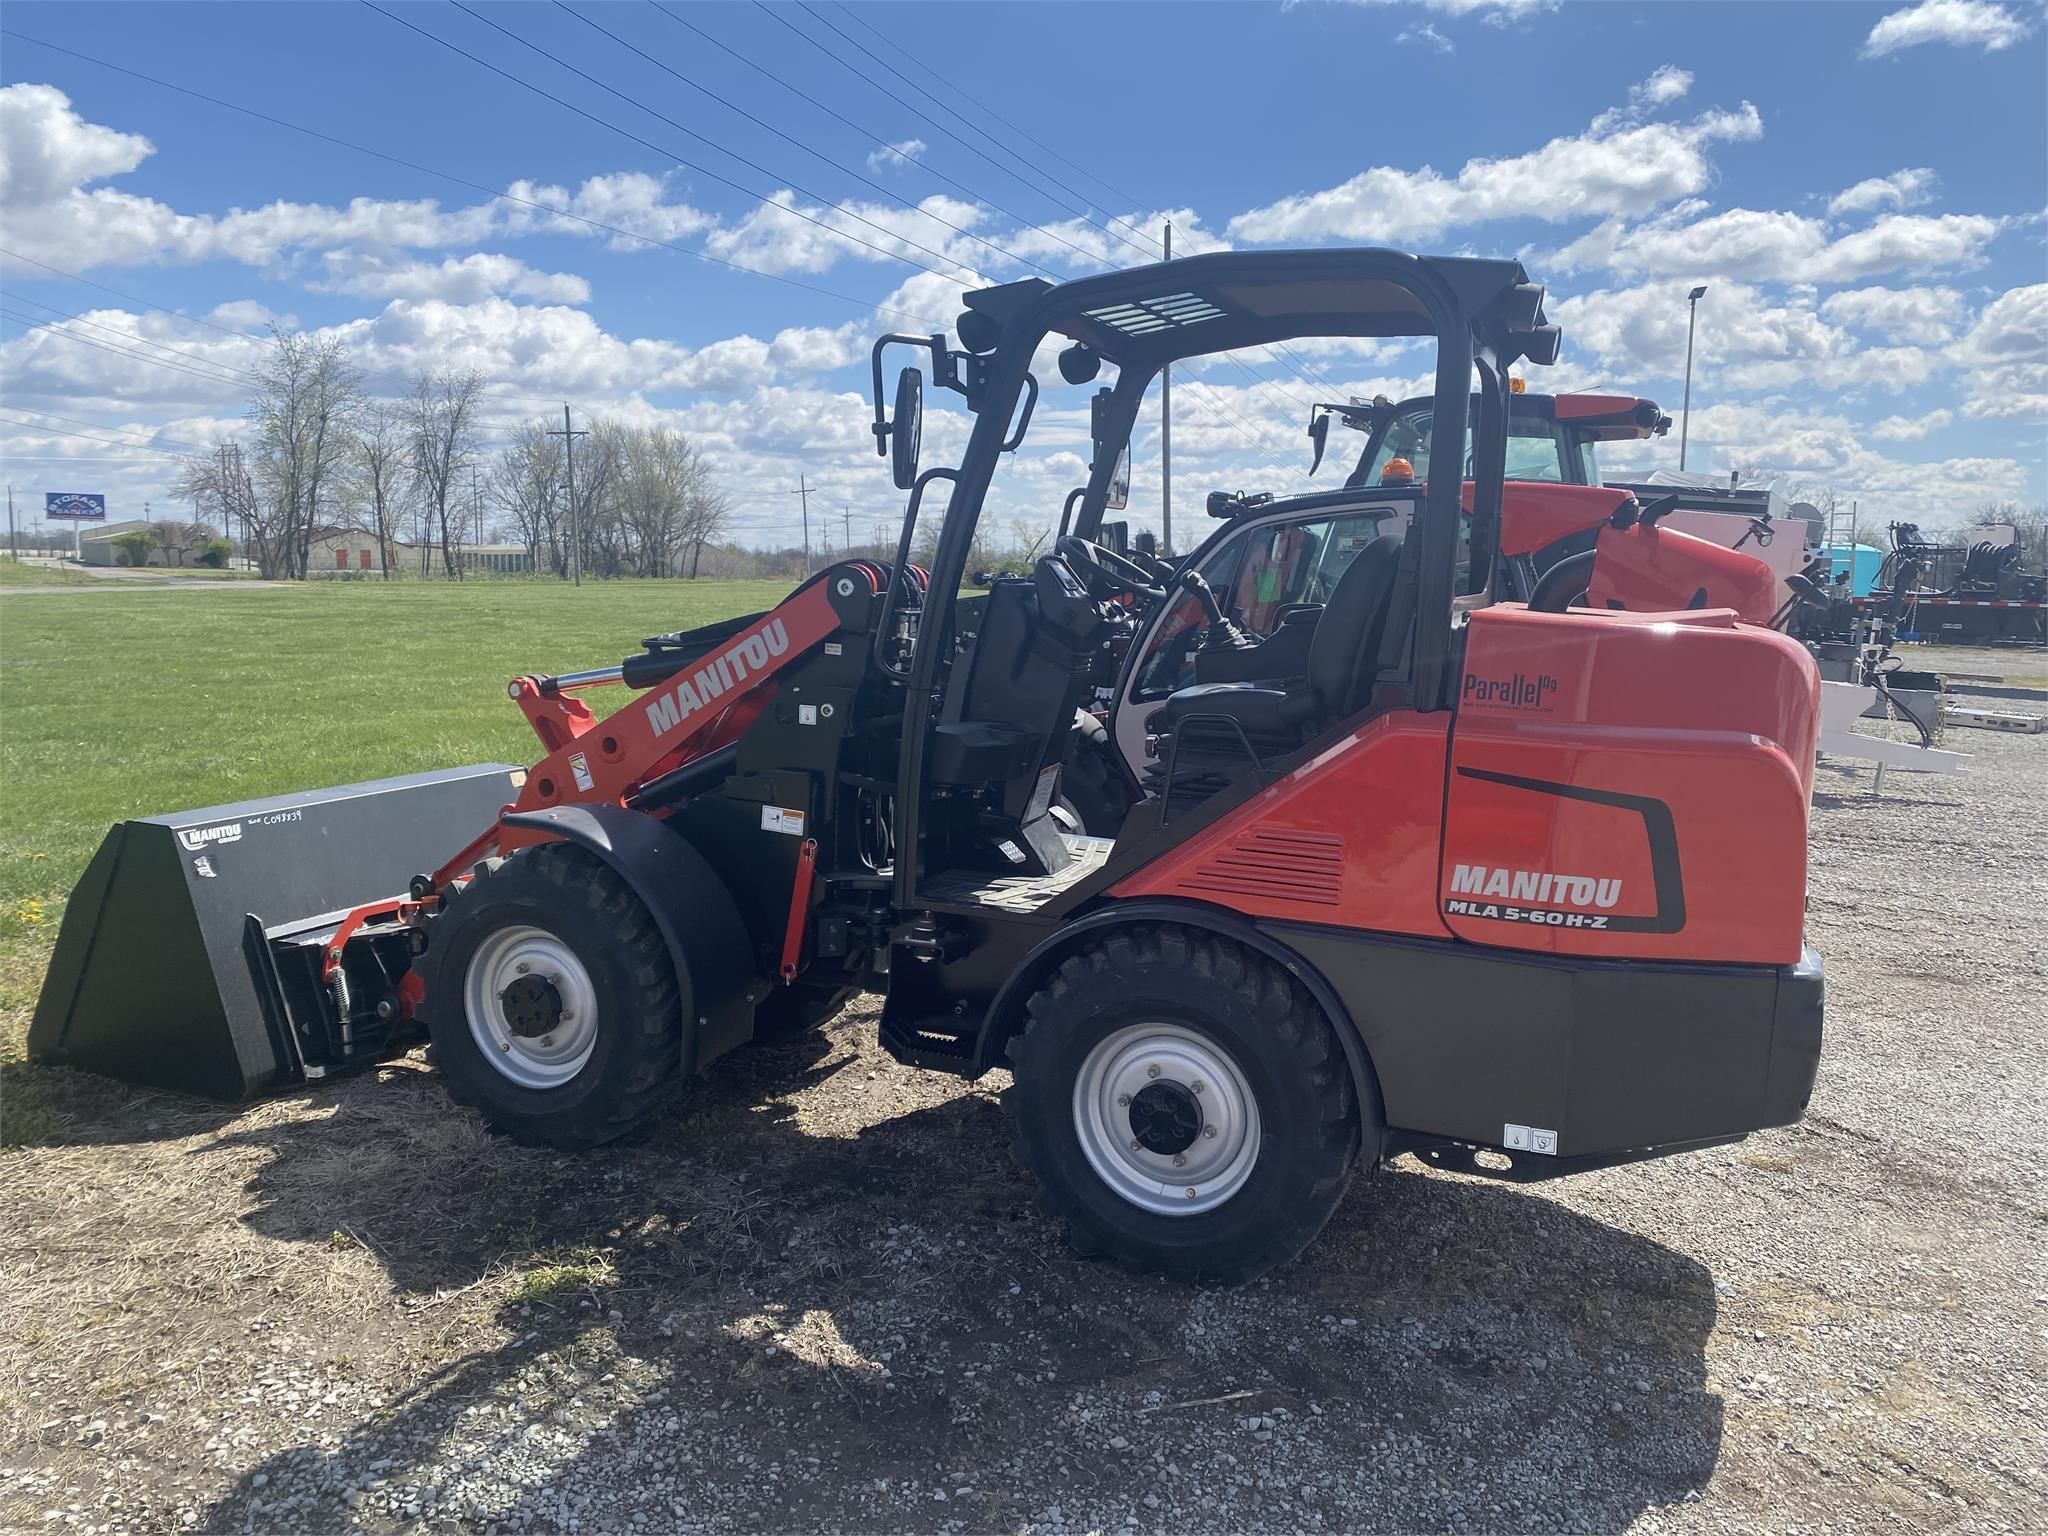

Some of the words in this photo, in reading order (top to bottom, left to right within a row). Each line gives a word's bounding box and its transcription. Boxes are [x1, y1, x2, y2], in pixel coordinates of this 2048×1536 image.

[48, 495, 103, 513] STORAGE
[645, 618, 789, 737] MANITOU
[189, 823, 241, 843] MANITOU
[1451, 864, 1622, 908] MANITOU
[1448, 901, 1498, 918] MLA
